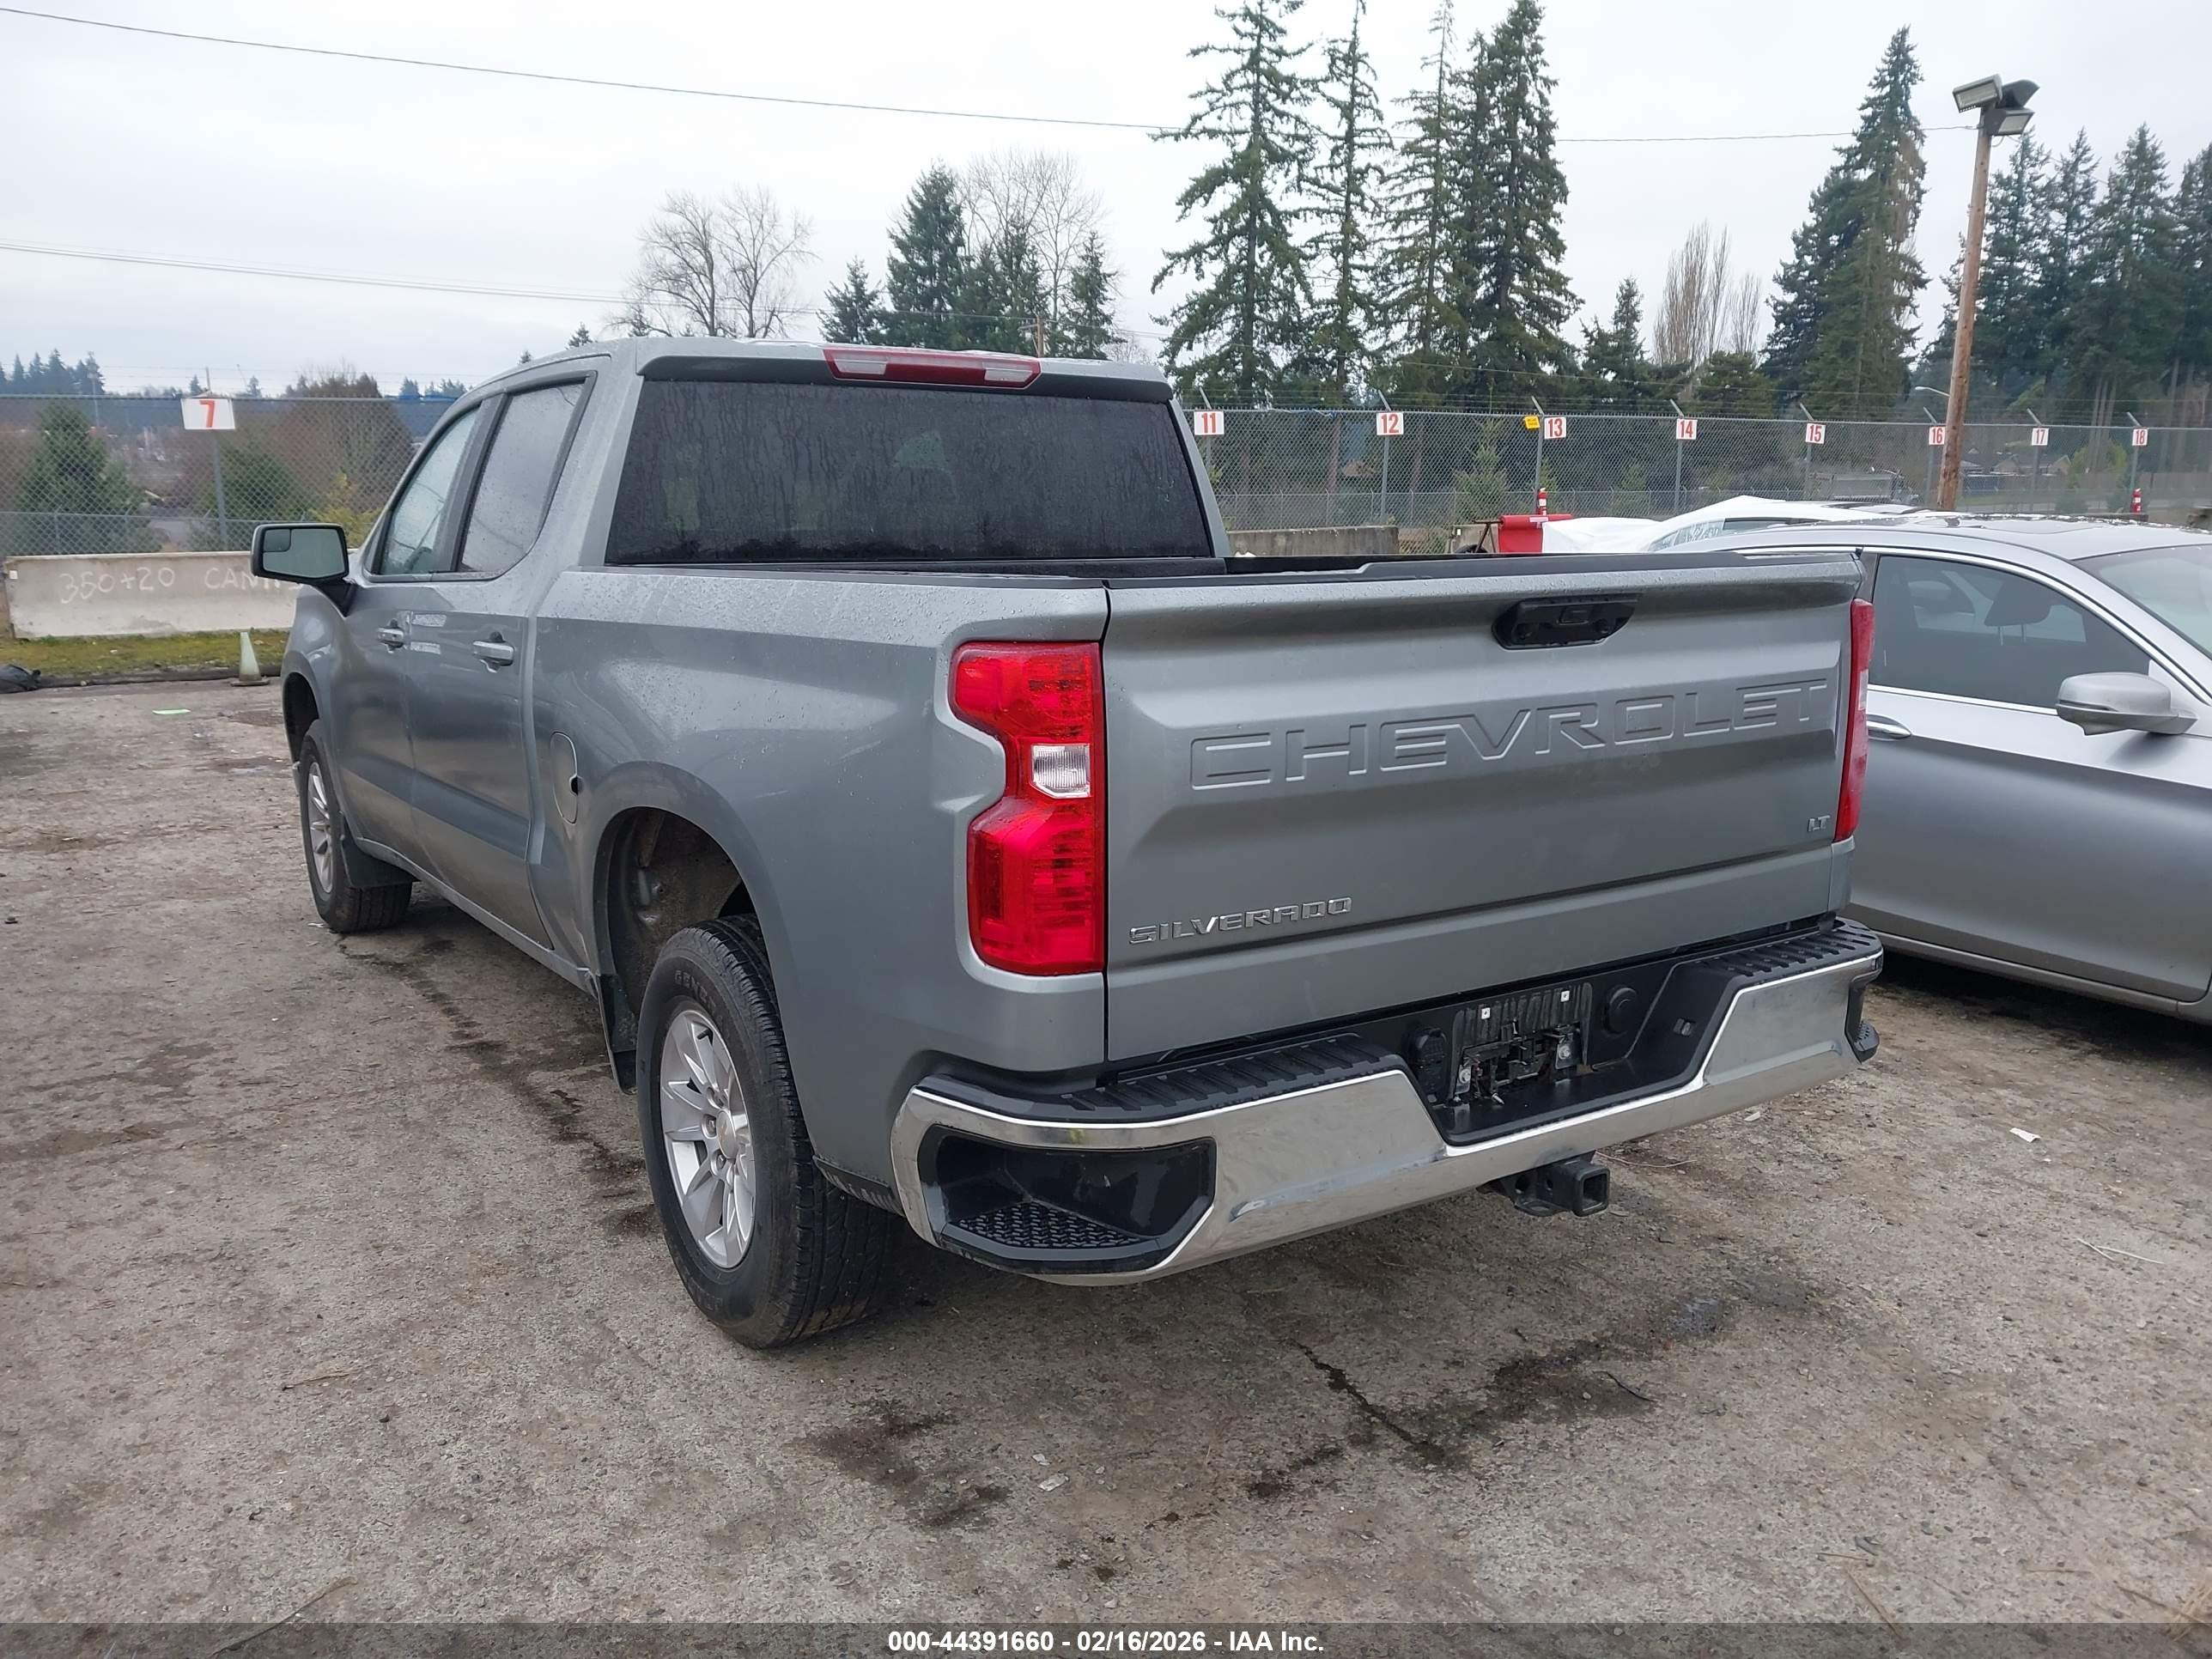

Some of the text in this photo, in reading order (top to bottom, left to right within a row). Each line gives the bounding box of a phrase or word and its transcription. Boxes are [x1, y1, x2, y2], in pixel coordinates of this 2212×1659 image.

[198, 399, 216, 428] 7
[1201, 413, 1217, 434] 11
[1381, 414, 1401, 434] 12
[1547, 417, 1564, 437] 13
[1680, 420, 1694, 438] 14
[1809, 424, 1823, 442] 15
[1932, 428, 1943, 444] 16
[2036, 428, 2046, 445] 17
[2136, 430, 2146, 445] 18
[1190, 678, 1828, 790] CHEVROLET
[1808, 815, 1831, 832] LT
[1128, 896, 1352, 945] SILVERADO
